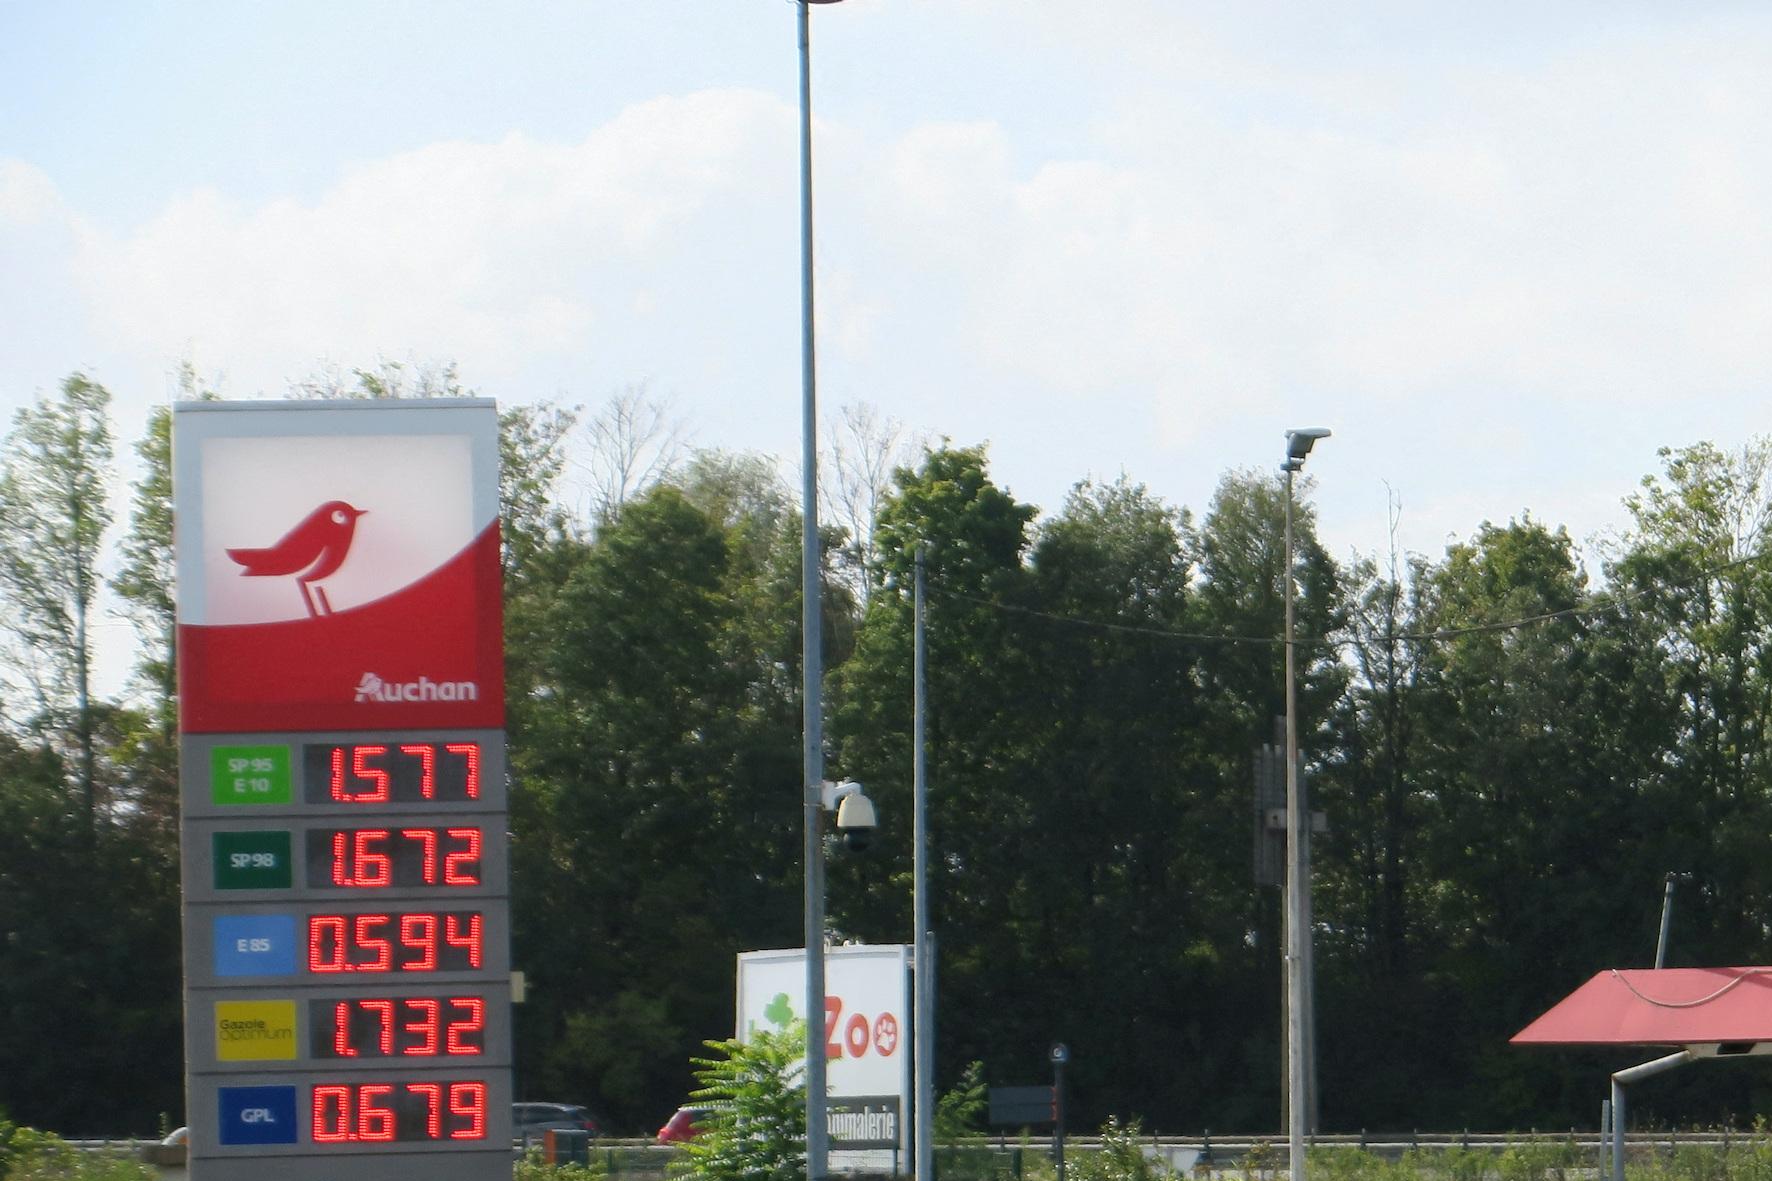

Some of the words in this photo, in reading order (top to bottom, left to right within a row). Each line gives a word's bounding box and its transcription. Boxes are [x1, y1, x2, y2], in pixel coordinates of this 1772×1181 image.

[355, 671, 477, 702] Auchan
[228, 758, 248, 772] SP
[250, 758, 273, 771] 95
[331, 744, 480, 801] 1.577
[234, 779, 246, 792] E
[248, 778, 270, 791] 10
[230, 854, 249, 868] SP
[251, 853, 275, 867] 98
[331, 829, 482, 886] 1.672
[236, 939, 248, 952] E
[249, 938, 271, 951] 85
[308, 914, 483, 972] 0.594
[219, 1018, 265, 1030] Gazole
[334, 998, 484, 1056] 1.732
[219, 1026, 292, 1041] optimum
[240, 1108, 275, 1123] GPL
[311, 1081, 488, 1142] 0.679
